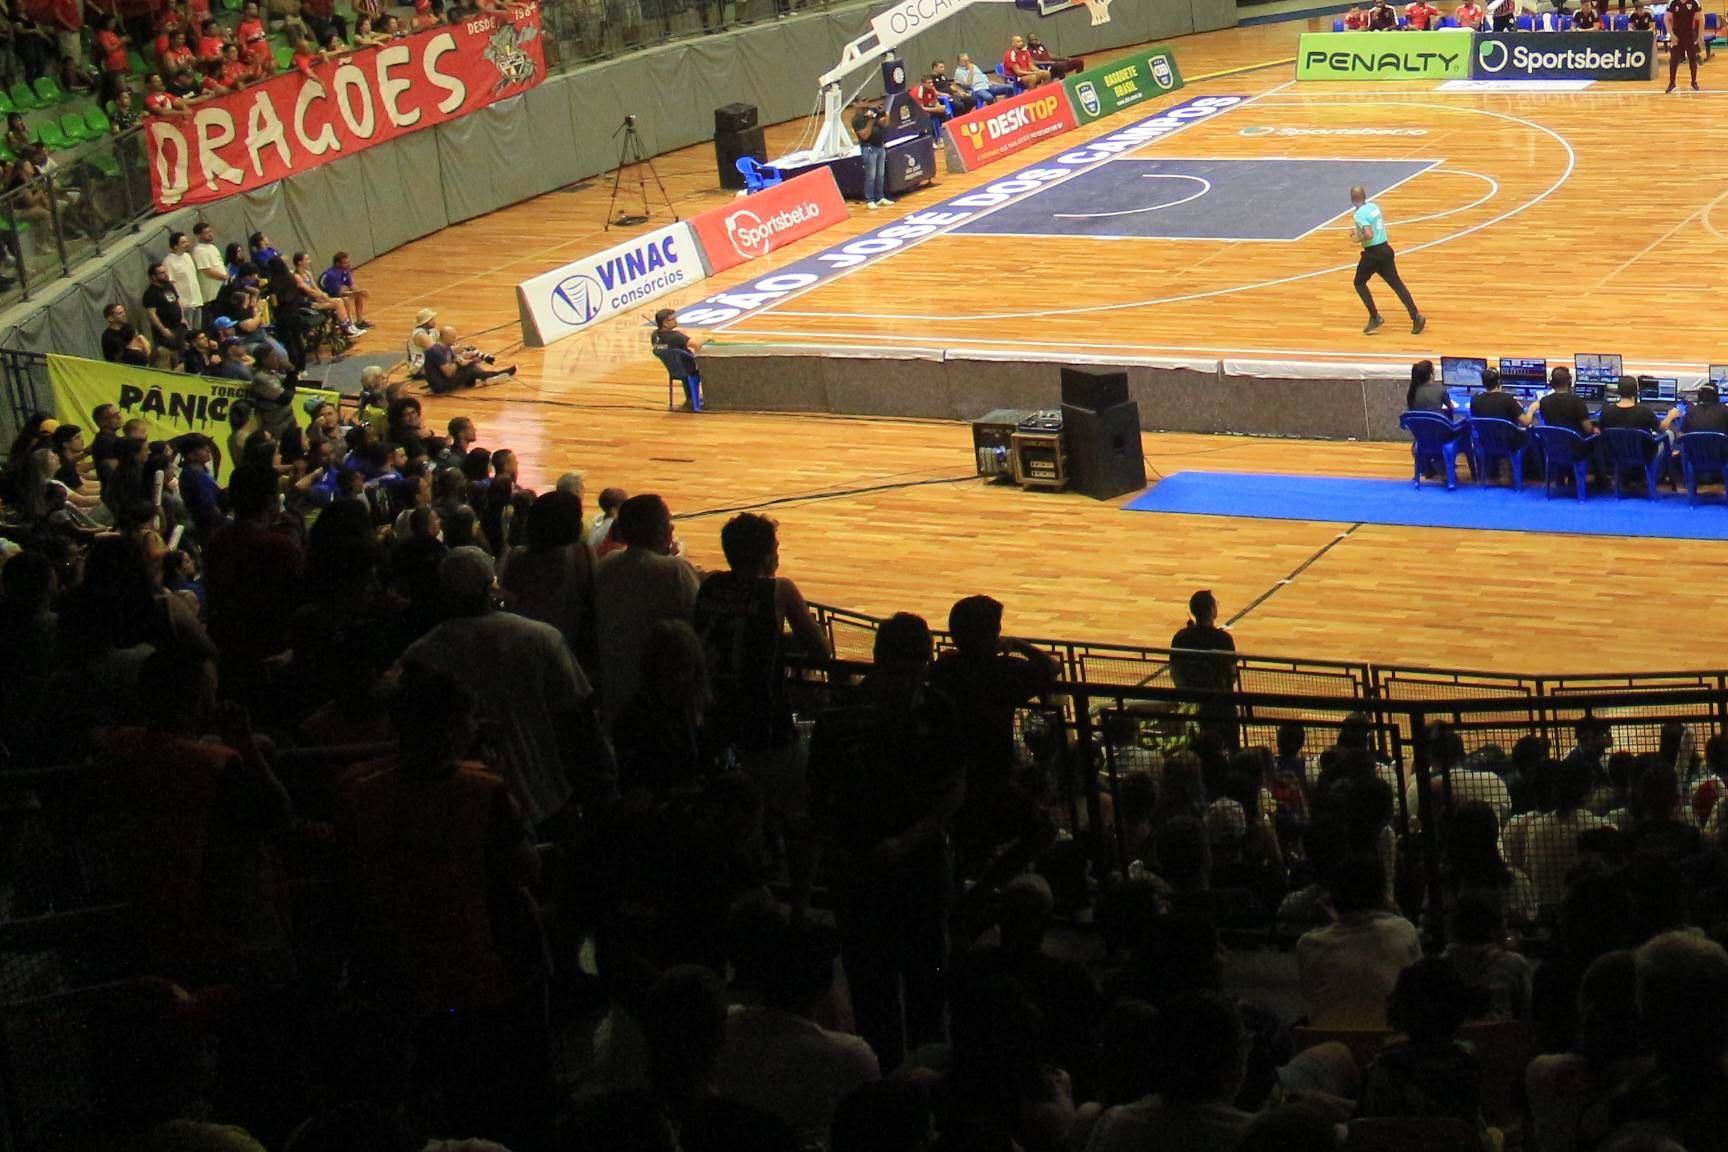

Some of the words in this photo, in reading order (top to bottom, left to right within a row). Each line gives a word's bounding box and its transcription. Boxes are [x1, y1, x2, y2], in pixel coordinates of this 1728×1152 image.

[467, 15, 496, 36] DESDE
[514, 1, 537, 21] 1984
[1104, 65, 1138, 88] BASQUETE
[1306, 51, 1459, 72] PENALTY
[1512, 46, 1646, 74] Sportsbet.io
[151, 32, 466, 206] DRAGÕES
[986, 95, 1058, 140] DESKTOP
[1275, 127, 1429, 136] Sportsbet.io
[675, 272, 820, 328] SÃO
[830, 210, 961, 268] JOSÉ
[953, 165, 1062, 212] DOS
[1057, 95, 1244, 165] CAMPOS
[737, 199, 820, 249] Sportsbet.io
[596, 235, 679, 291] VINAC
[611, 269, 684, 310] consórcios
[119, 384, 229, 432] PÂNIC
